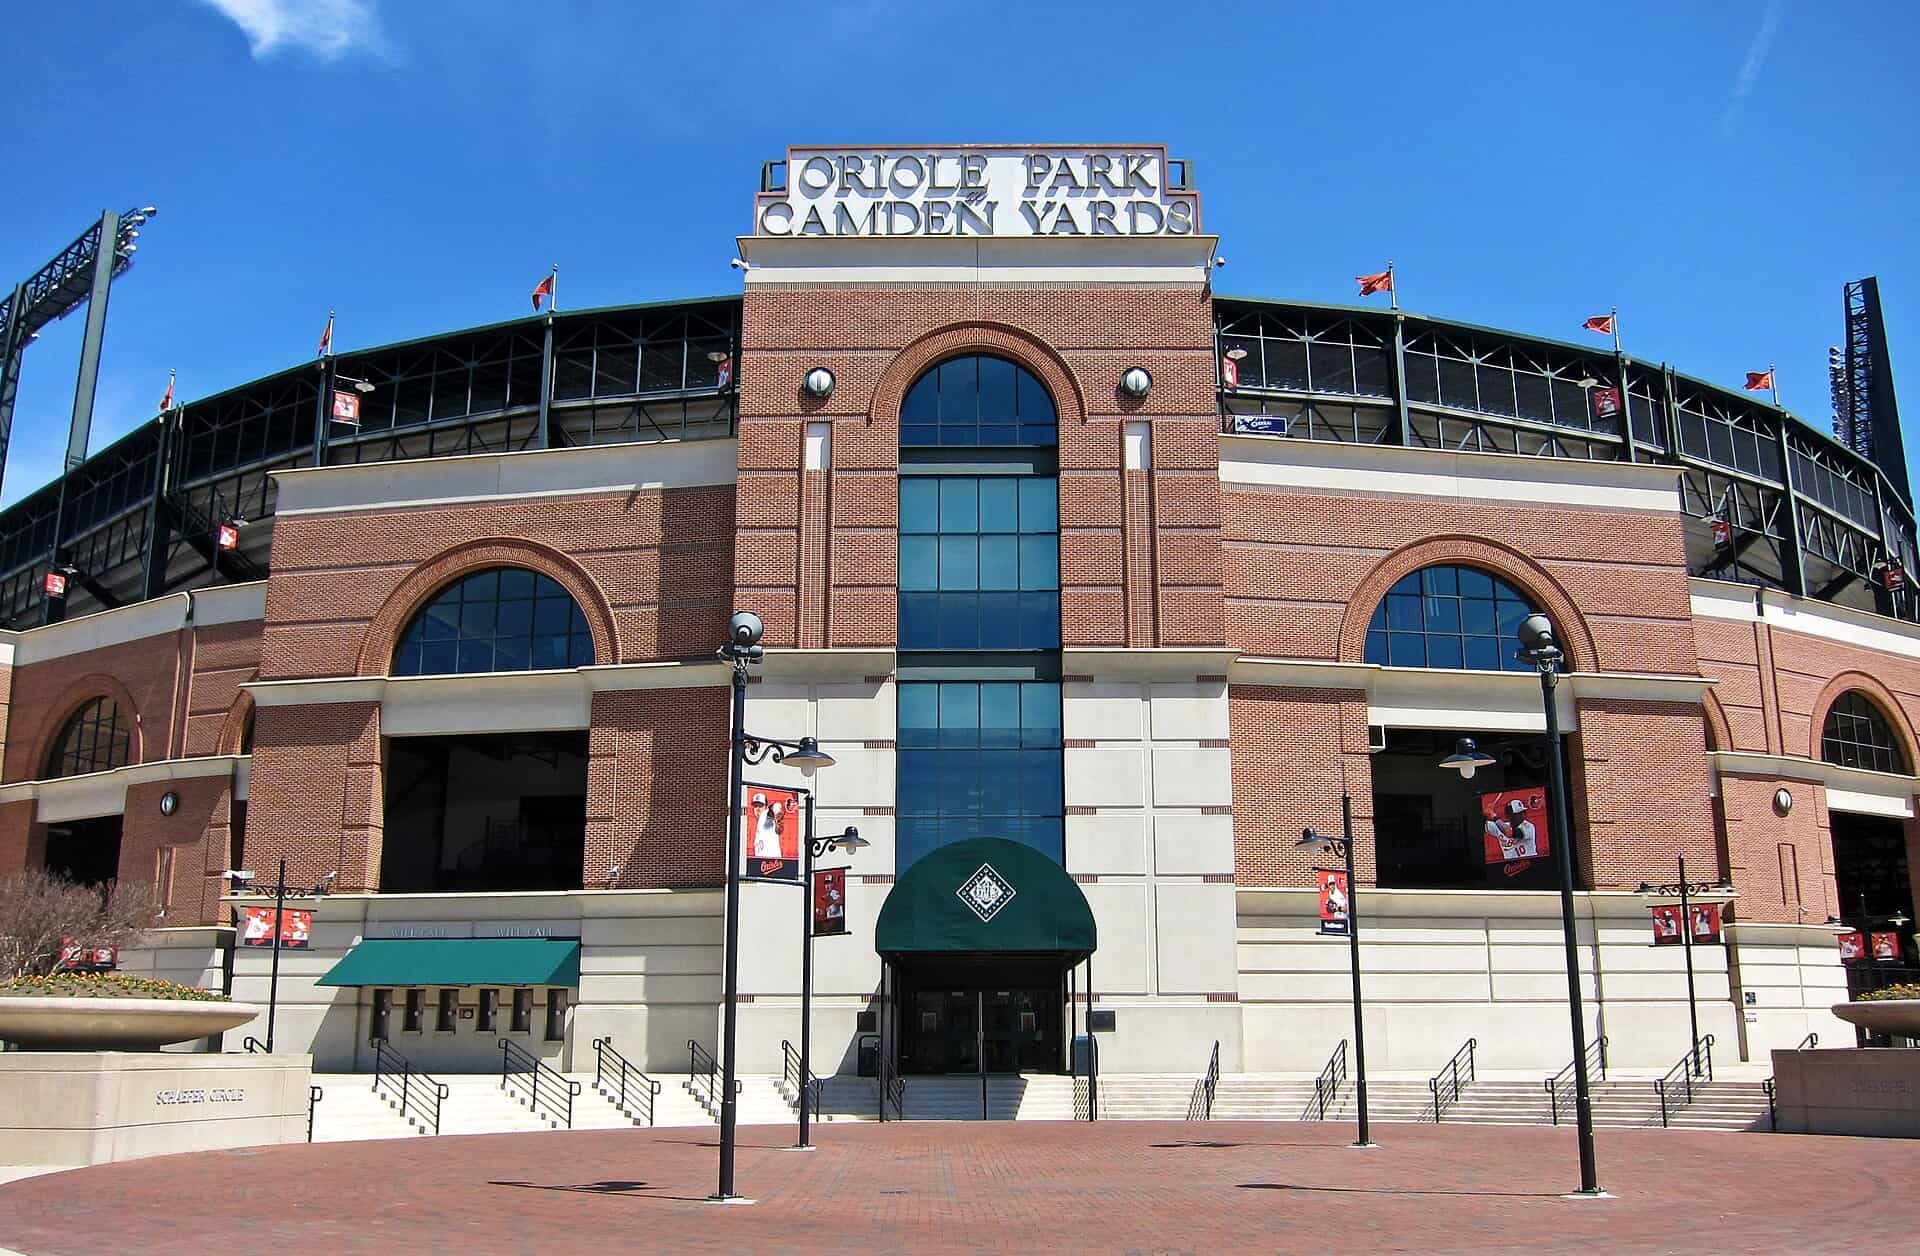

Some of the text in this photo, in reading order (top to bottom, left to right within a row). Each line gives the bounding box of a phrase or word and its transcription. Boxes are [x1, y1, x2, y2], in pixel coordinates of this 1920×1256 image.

[800, 154, 1157, 193] ORIOLE PARK
[760, 200, 1192, 236] CAMDEN YARDS
